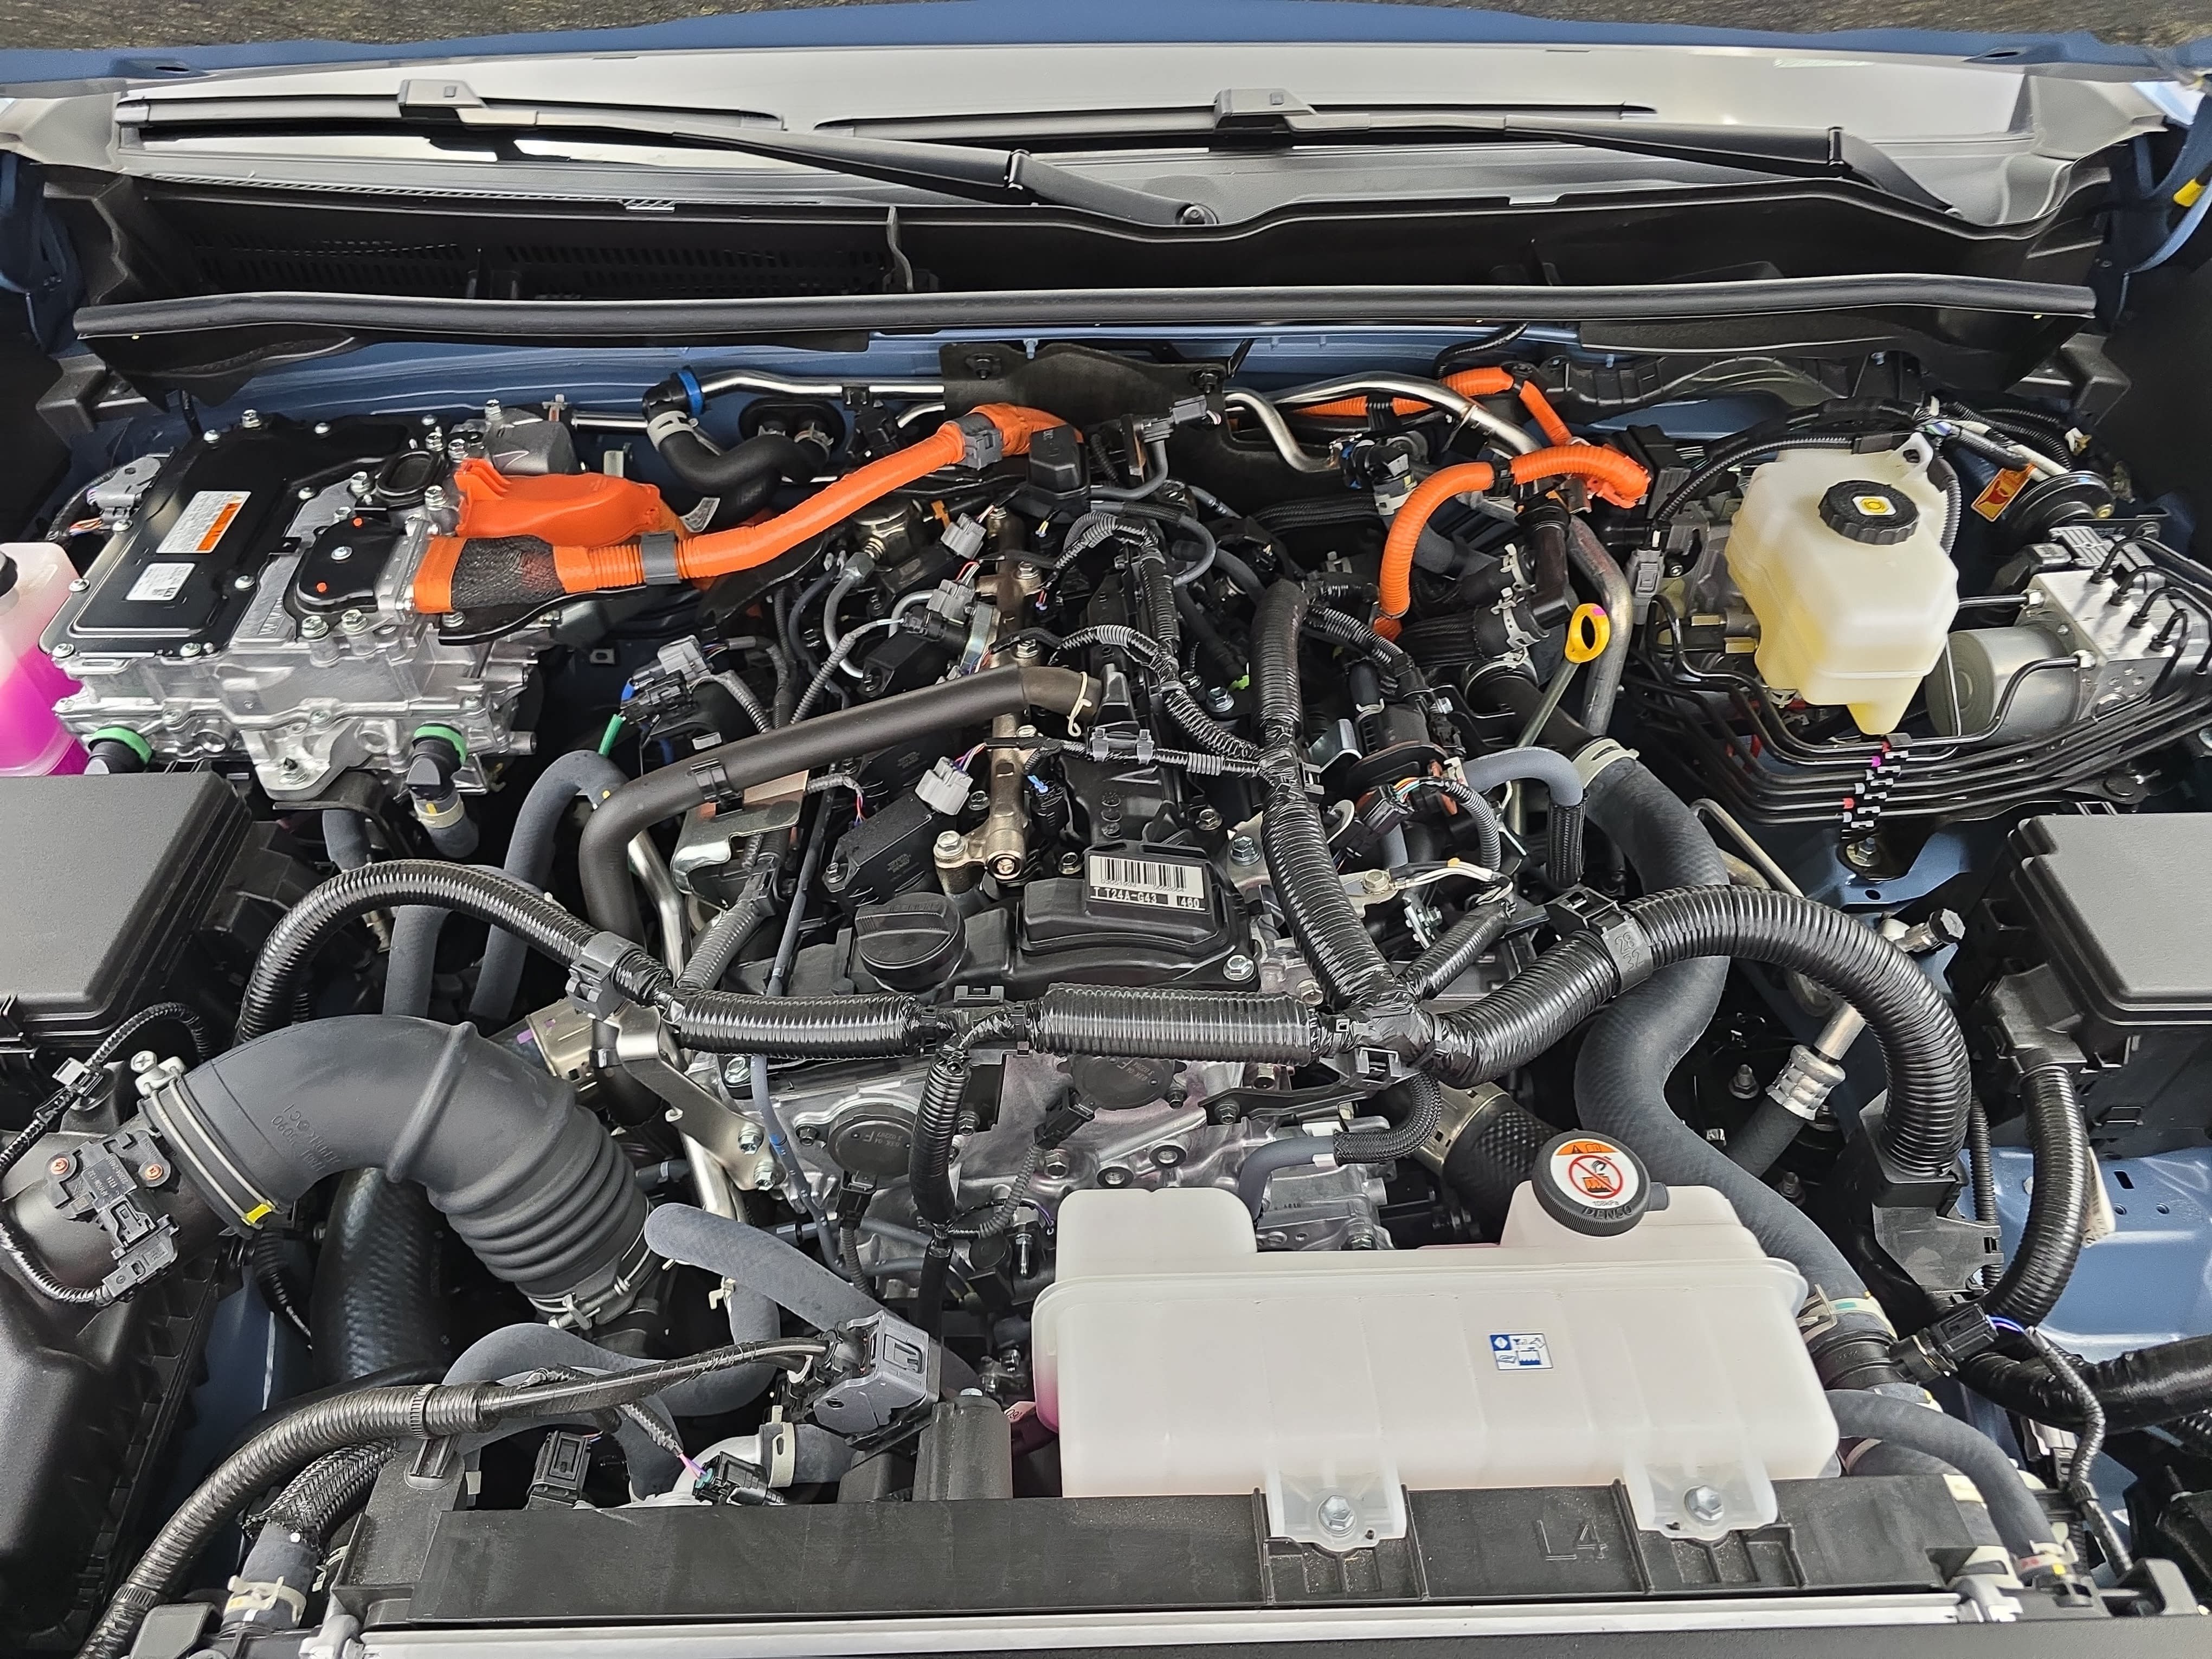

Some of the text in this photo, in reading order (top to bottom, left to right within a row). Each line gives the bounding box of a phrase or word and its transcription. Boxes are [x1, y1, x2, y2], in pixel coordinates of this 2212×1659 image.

[1105, 888, 1157, 904] T24A-G43
[1181, 897, 1200, 908] 460
[1615, 932, 1635, 955] 28
[1623, 949, 1644, 972] 32
[1581, 1205, 1633, 1220] DENSO
